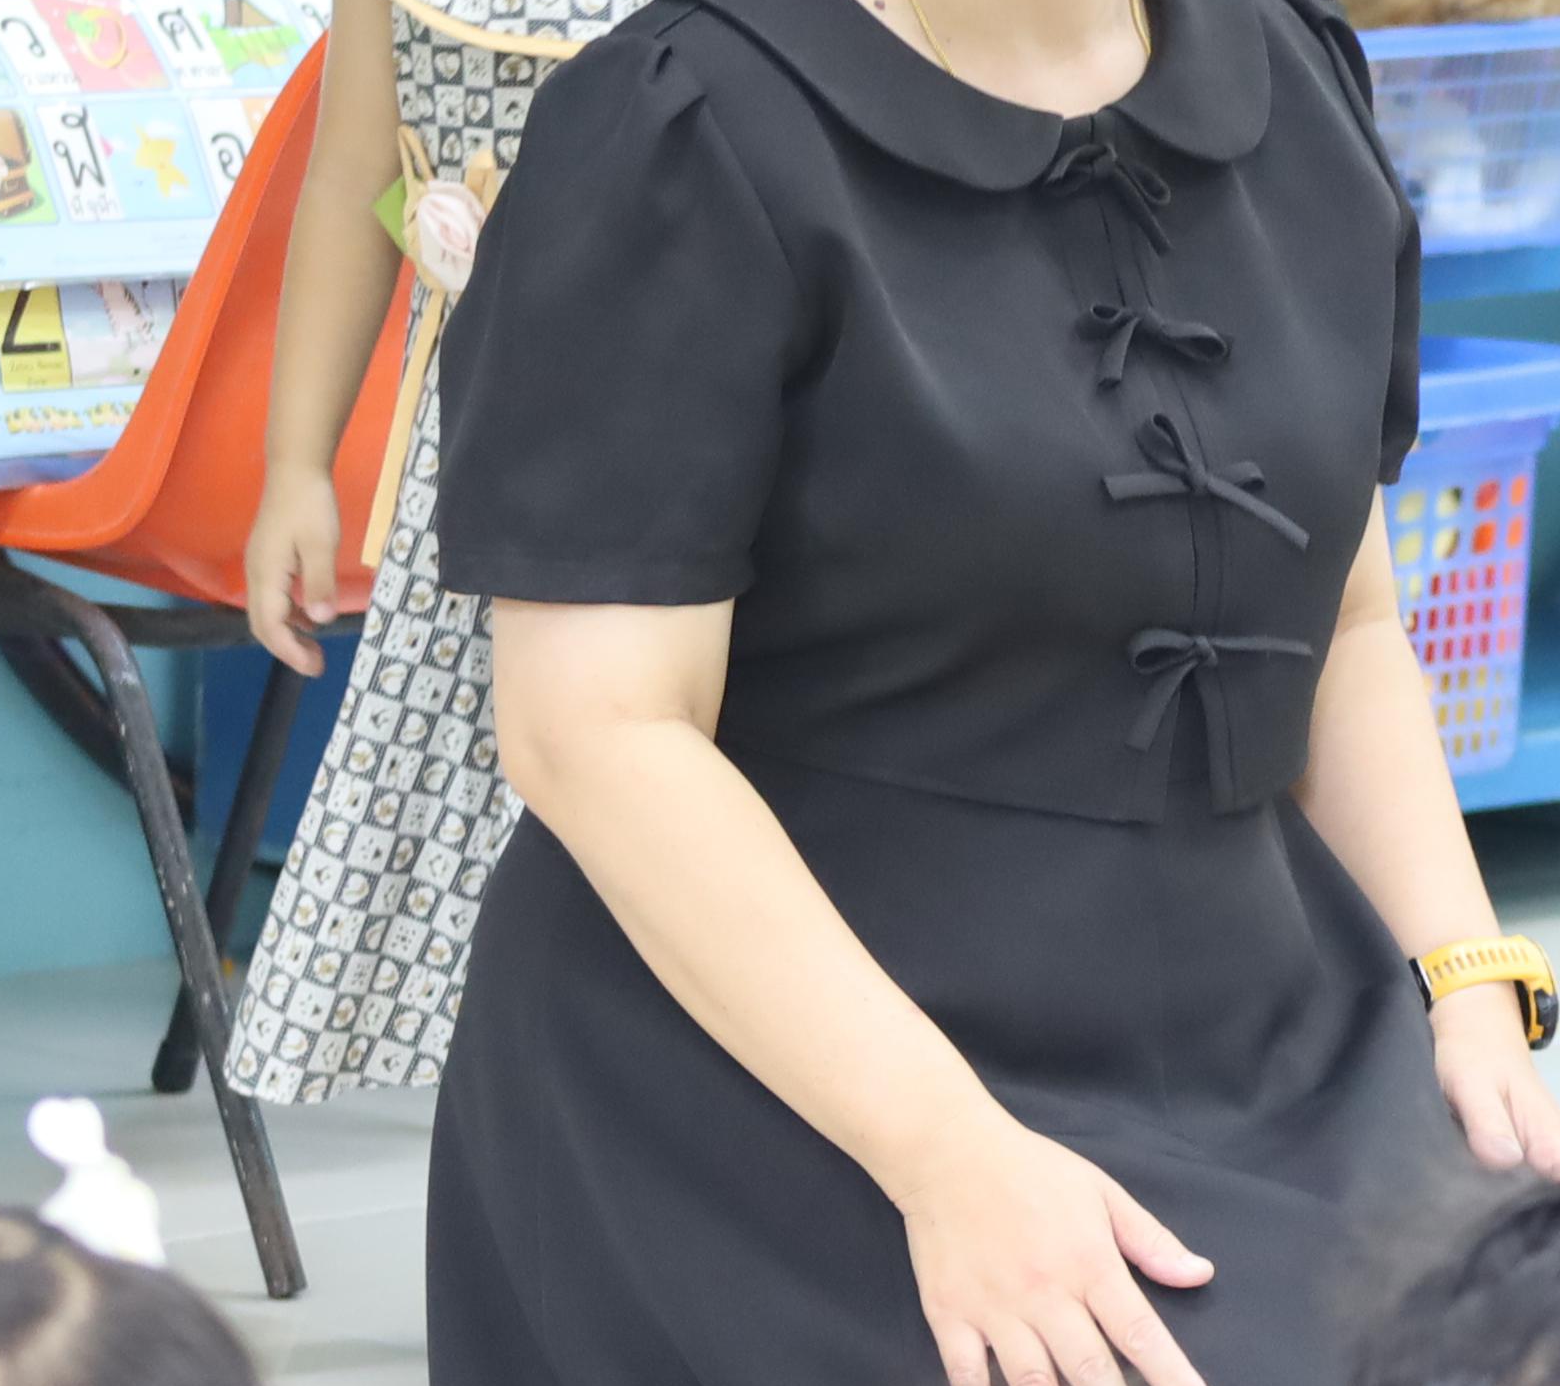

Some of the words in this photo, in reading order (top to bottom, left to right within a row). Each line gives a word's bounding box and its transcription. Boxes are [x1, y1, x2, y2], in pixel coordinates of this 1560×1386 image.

[0, 15, 47, 59] ว
[157, 5, 206, 54] ศ
[51, 103, 107, 191] ฬ
